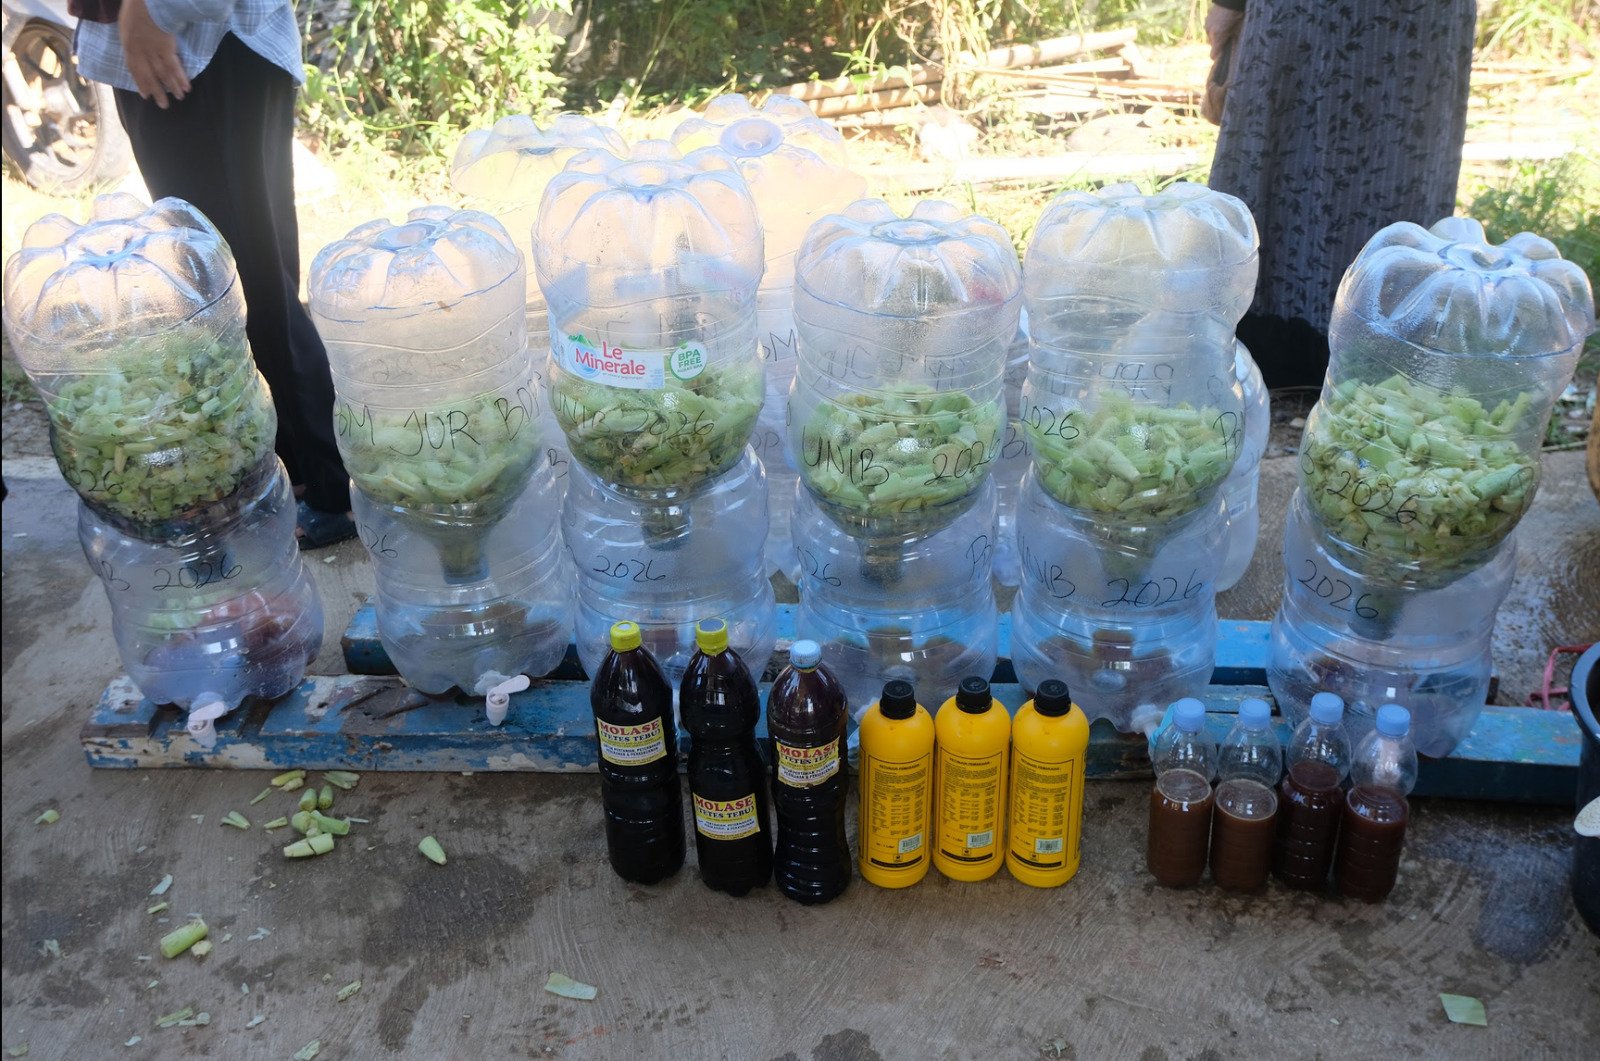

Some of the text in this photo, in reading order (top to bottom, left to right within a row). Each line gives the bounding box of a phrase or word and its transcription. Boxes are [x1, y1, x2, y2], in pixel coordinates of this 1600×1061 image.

[575, 348, 646, 376] Minerale
[602, 341, 623, 360] Le
[678, 349, 700, 361] BPA
[678, 357, 702, 368] FREE
[608, 407, 714, 449] 2026
[1020, 396, 1080, 440] 2026
[802, 426, 1001, 486] UNIB 2026
[1327, 470, 1420, 524] 2026
[152, 553, 243, 591] 2026
[592, 555, 666, 583] 2026
[1101, 568, 1203, 608] 2026
[1298, 559, 1379, 619] 2026
[600, 720, 659, 736] MOLASE
[695, 796, 754, 812] MOLASE
